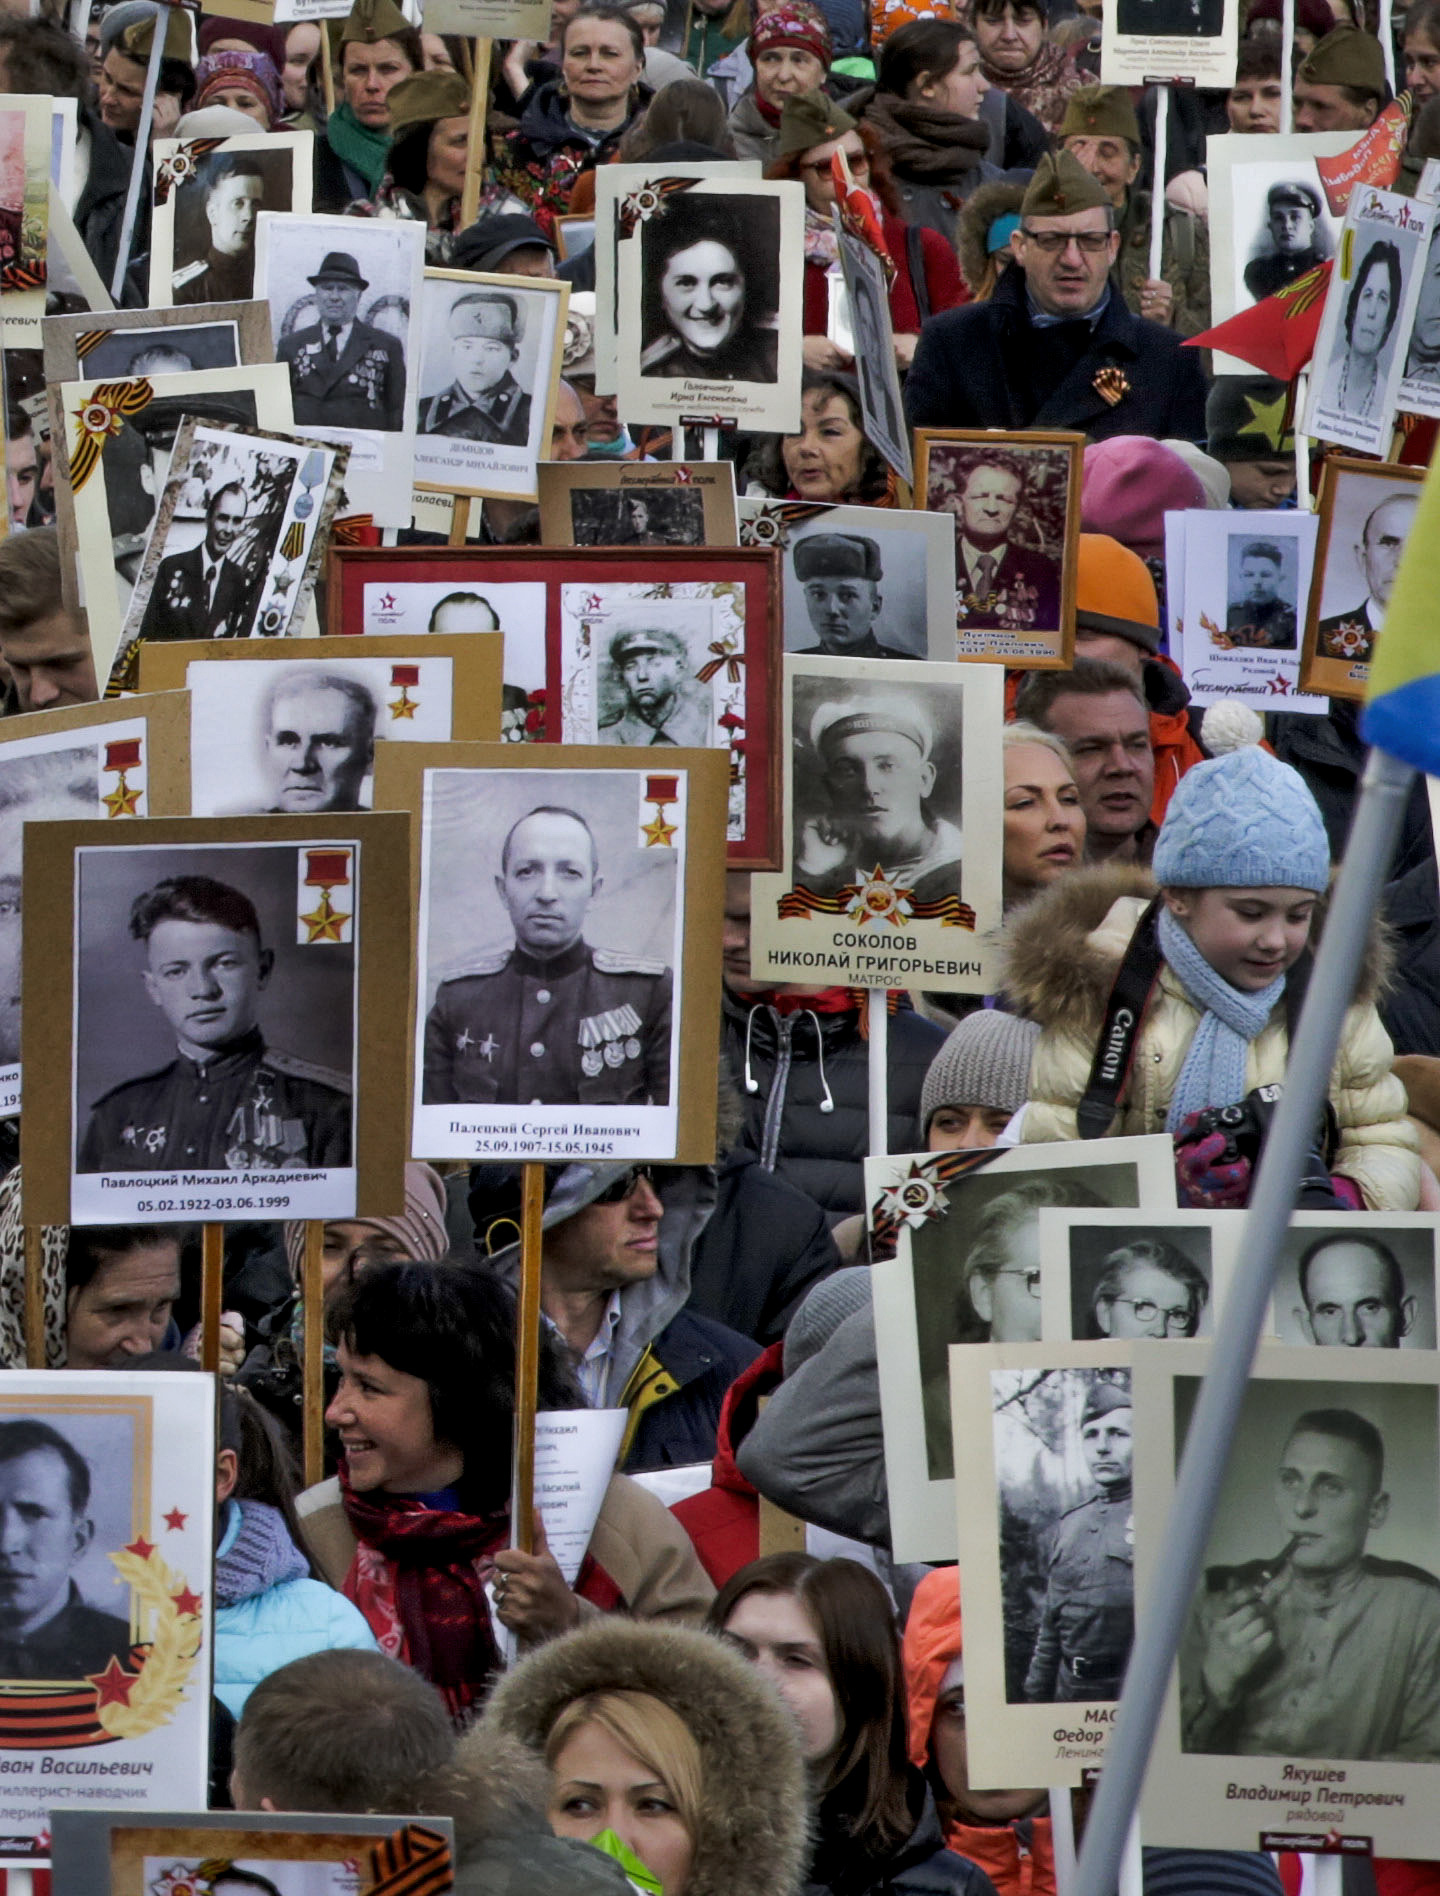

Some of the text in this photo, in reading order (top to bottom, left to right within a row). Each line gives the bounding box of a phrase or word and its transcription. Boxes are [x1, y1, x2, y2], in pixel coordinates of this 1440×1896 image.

[448, 442, 494, 455] ДЕМИДОВ
[466, 457, 529, 474] МИХАЙЛОВИЧ
[692, 473, 716, 485] ПОЛК
[1190, 671, 1268, 697] бессмертный
[832, 934, 918, 951] СОКОЛОВ
[767, 949, 982, 976] НИКОЛАЙ ГРИГОРЬЕВИЧ
[848, 972, 903, 988] МАТРОС
[1100, 1007, 1135, 1081] Canon
[449, 1120, 641, 1140] Палецкий Сергей Иванович
[474, 1139, 614, 1155] 25.09.1907-15.05.1945
[100, 1169, 328, 1190] Павлоцкий Михаил Аркадиевич
[136, 1195, 291, 1213] 05.02.1922-03.06.1999
[1053, 1727, 1104, 1746] Федор
[40, 1756, 154, 1777] Васильевич
[1281, 1764, 1347, 1785] Якушев
[1225, 1783, 1406, 1809] Владимир Петрович
[1286, 1808, 1346, 1826] рядовой
[1264, 1835, 1368, 1850] бессмертный ПОЛК
